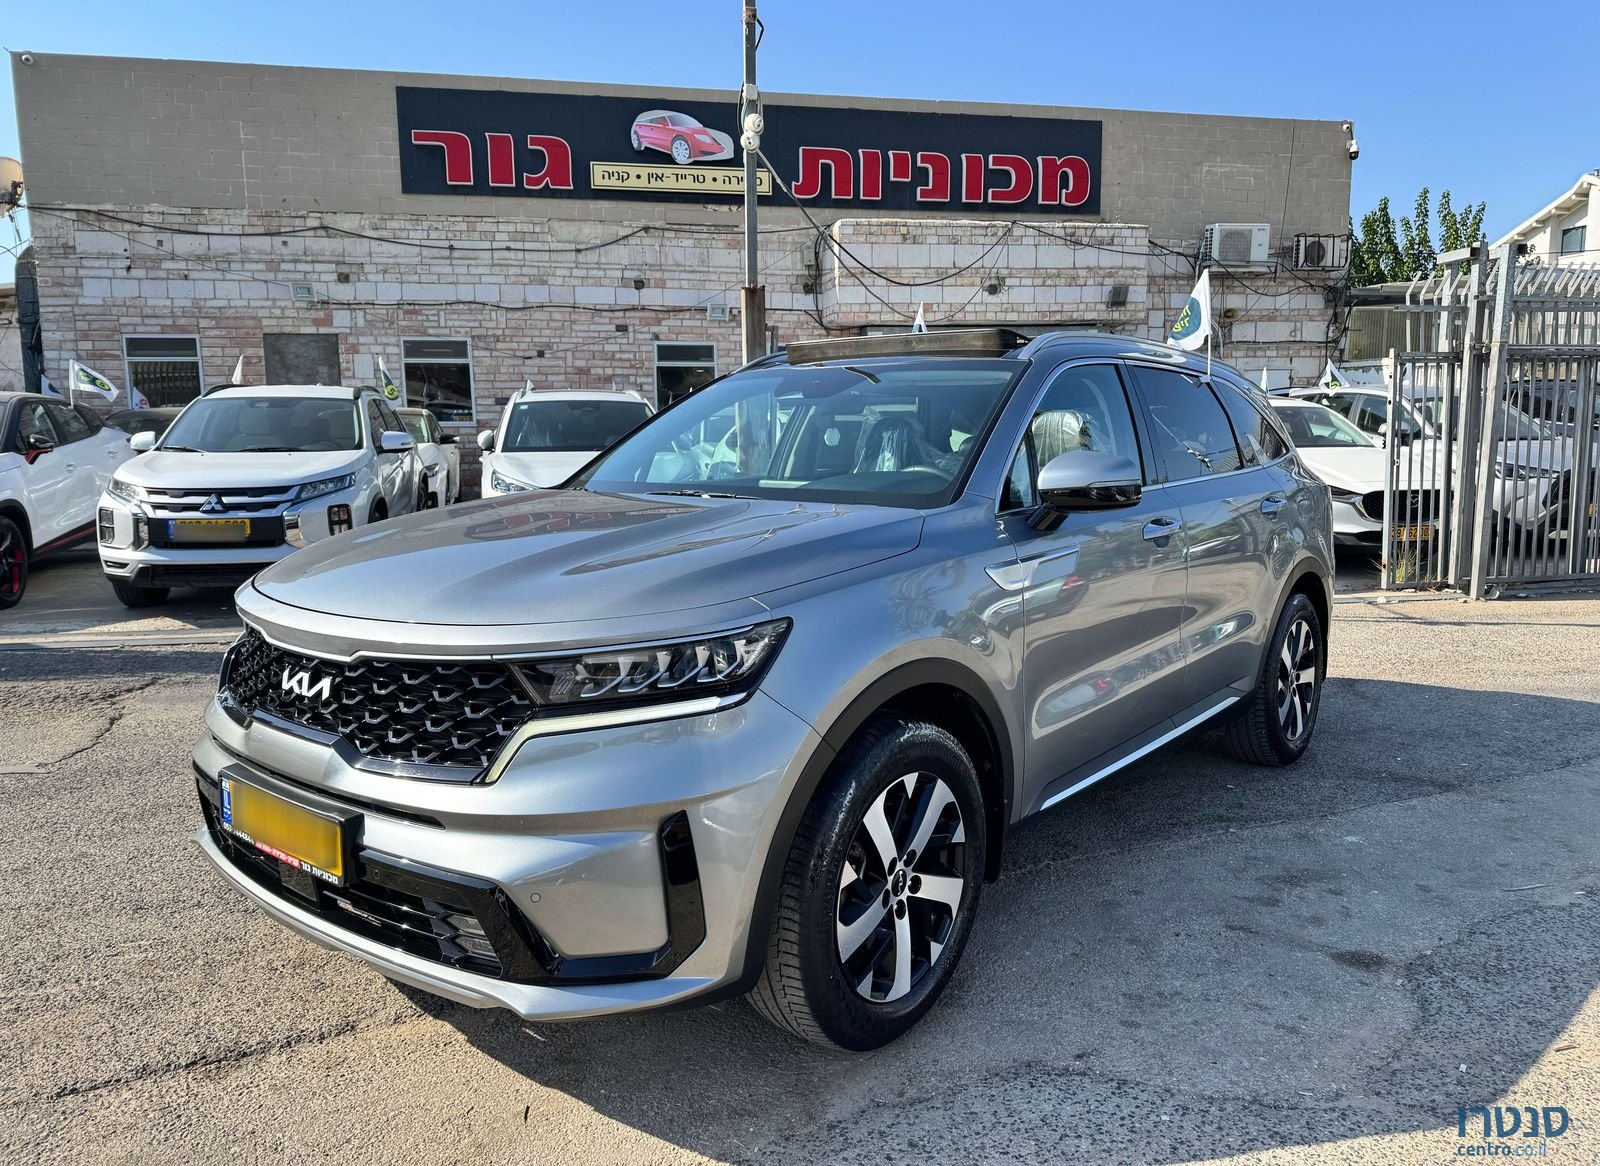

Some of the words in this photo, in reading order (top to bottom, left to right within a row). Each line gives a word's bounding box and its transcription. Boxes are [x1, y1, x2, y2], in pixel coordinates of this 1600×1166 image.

[411, 129, 574, 190] גור
[601, 169, 630, 183] קניה
[791, 146, 1091, 207] מכוניות
